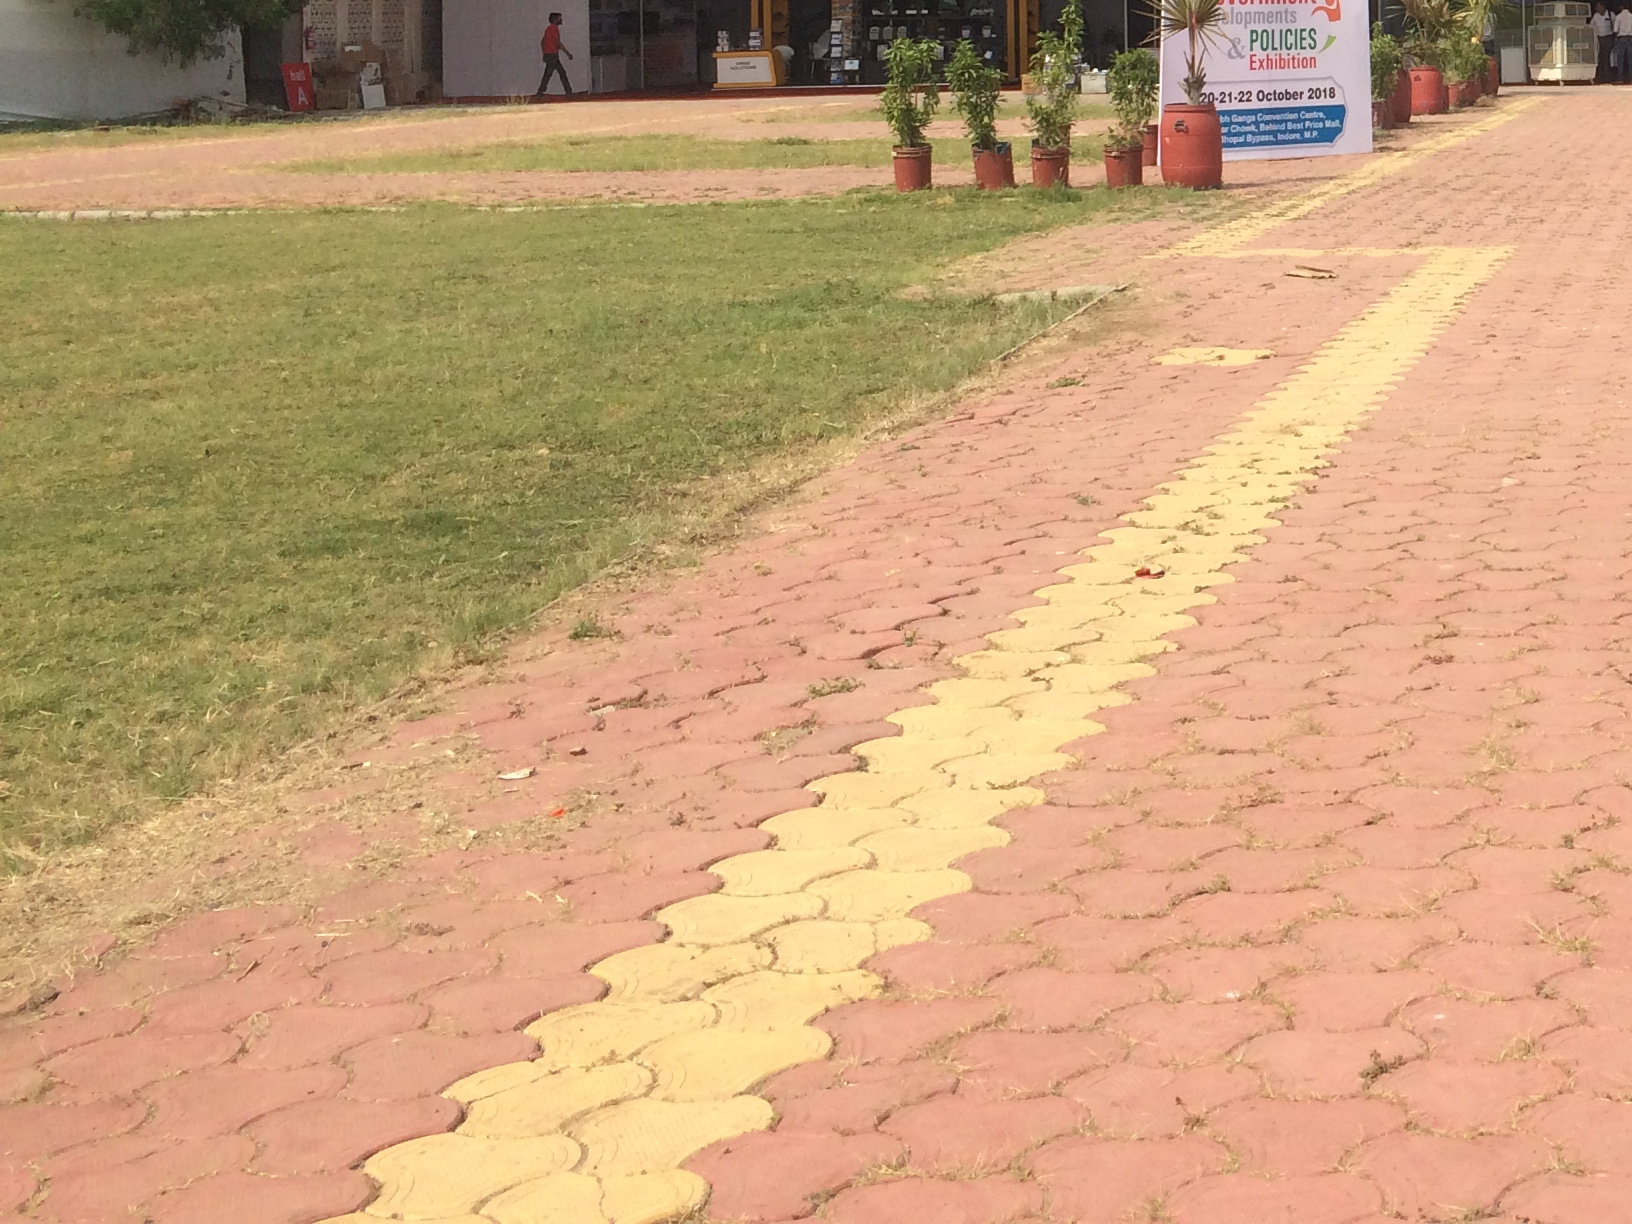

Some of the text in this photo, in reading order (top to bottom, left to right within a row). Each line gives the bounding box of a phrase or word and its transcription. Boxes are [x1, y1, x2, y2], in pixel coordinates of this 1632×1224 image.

[1249, 28, 1318, 51] POLICIES
[1227, 37, 1246, 60] &
[1249, 53, 1318, 71] Exhibition
[289, 69, 306, 81] hall
[298, 86, 309, 106] A
[1256, 88, 1304, 102] October
[1307, 87, 1336, 100] 2018
[1231, 114, 1256, 123] Ganga
[1257, 112, 1299, 122] Convention
[1287, 121, 1304, 130] Best
[1305, 120, 1324, 129] Price
